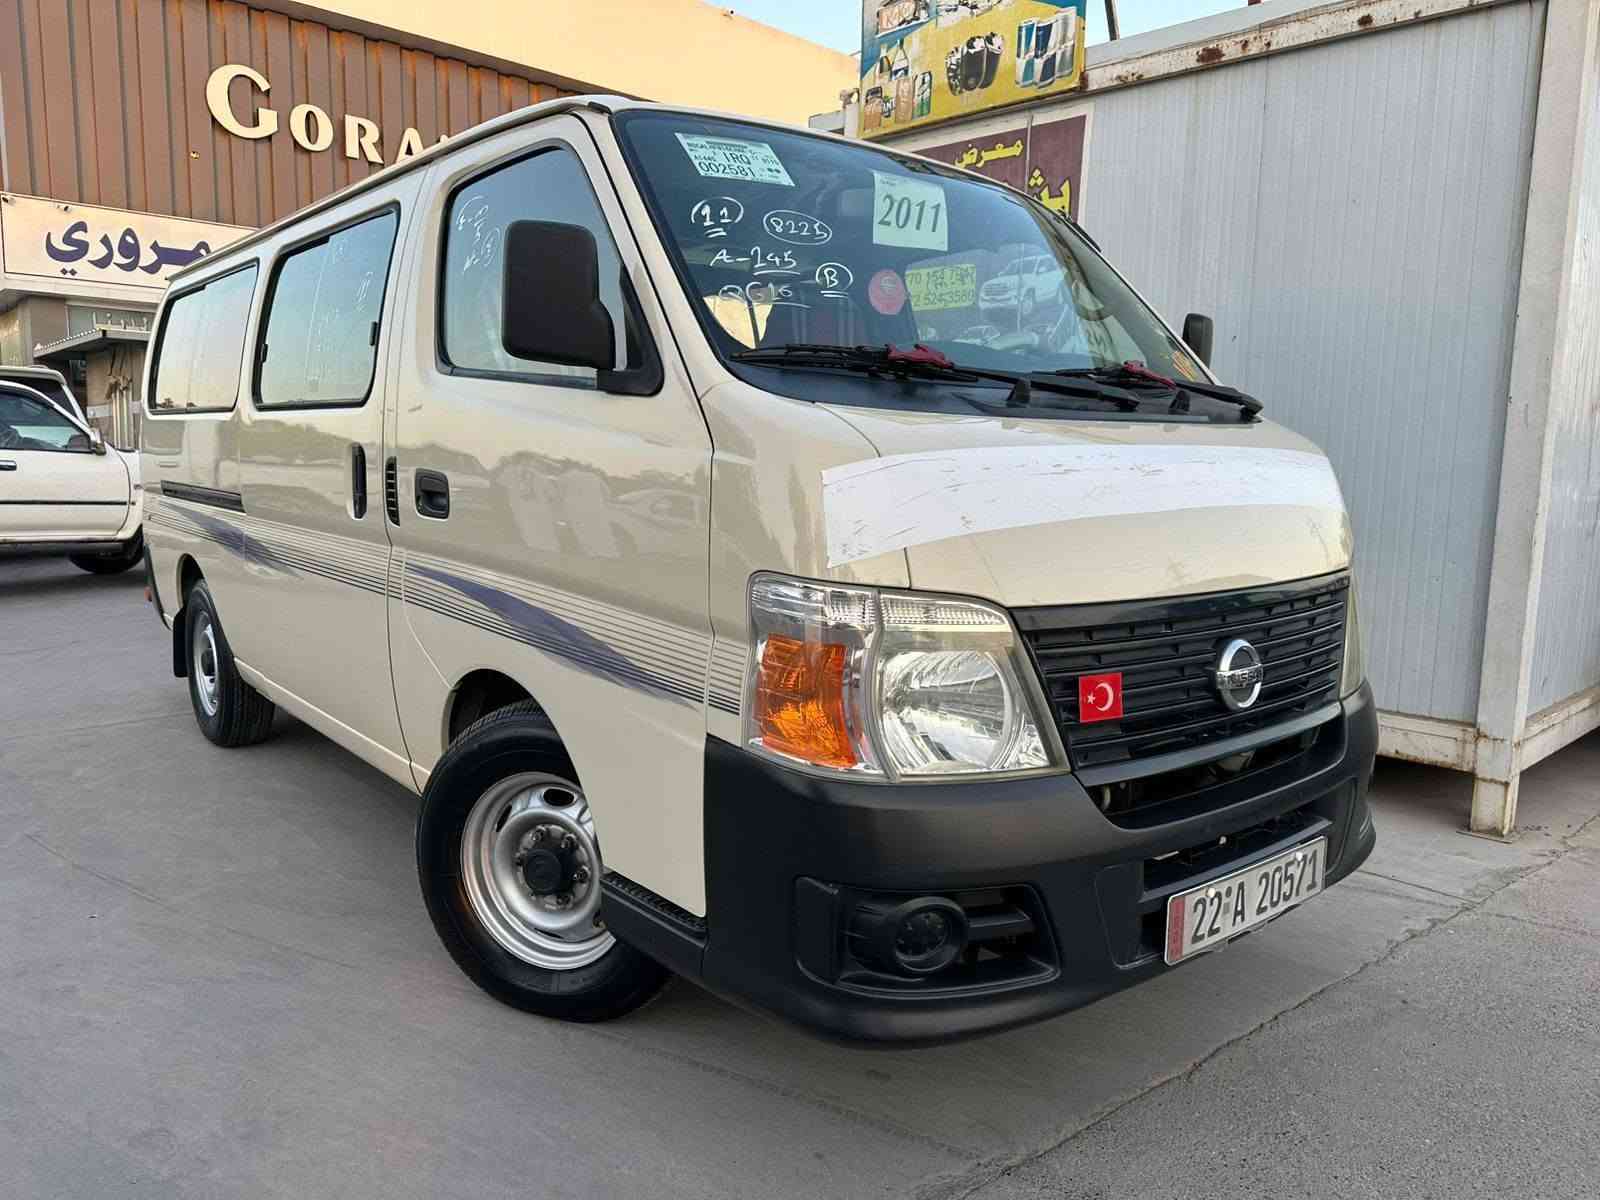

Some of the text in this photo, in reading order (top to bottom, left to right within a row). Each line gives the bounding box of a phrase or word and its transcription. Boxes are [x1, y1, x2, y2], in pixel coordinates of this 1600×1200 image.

[206, 64, 448, 165] GORA
[698, 161, 756, 177] 002581
[878, 193, 941, 233] 2011
[1191, 848, 1319, 945] 22 A 20571
